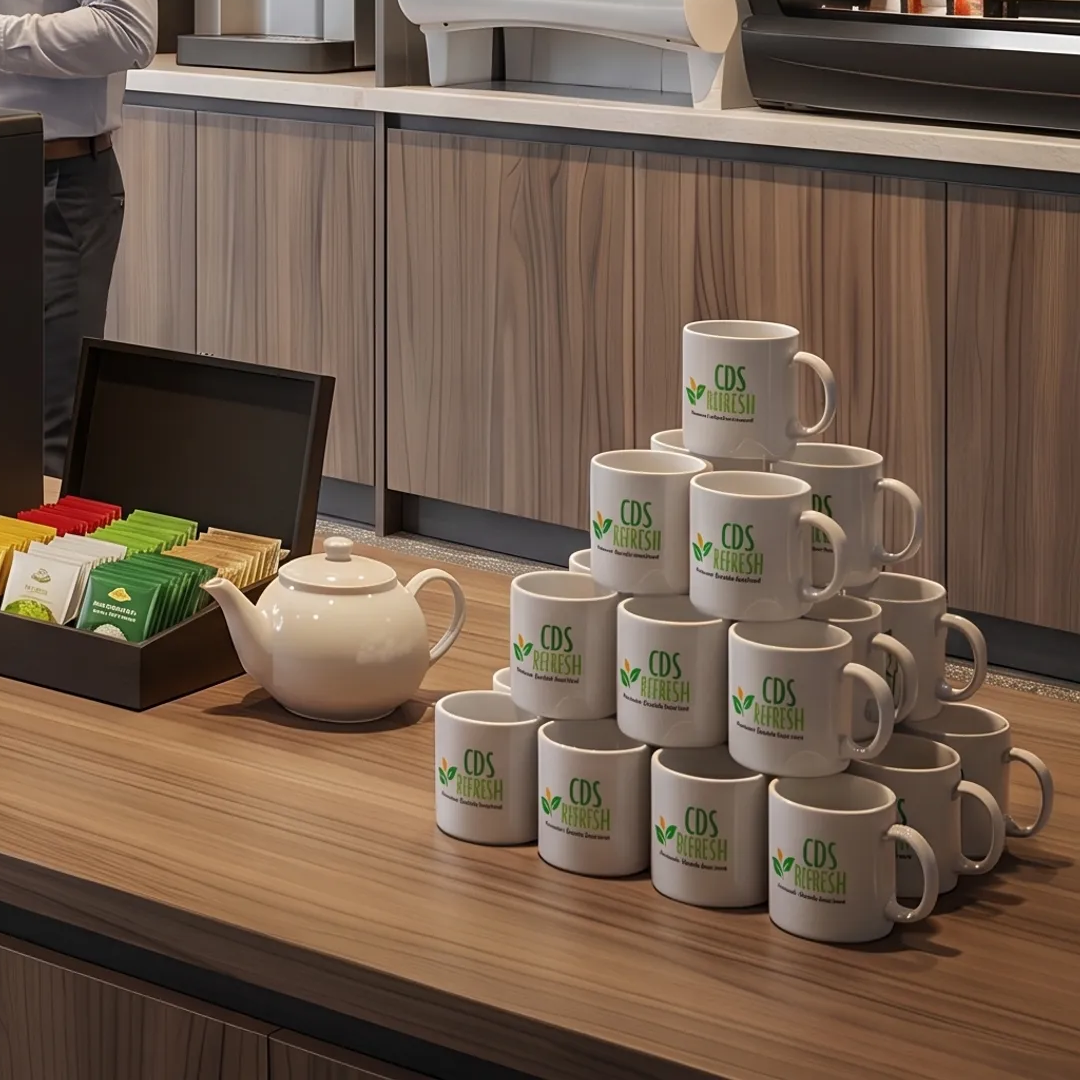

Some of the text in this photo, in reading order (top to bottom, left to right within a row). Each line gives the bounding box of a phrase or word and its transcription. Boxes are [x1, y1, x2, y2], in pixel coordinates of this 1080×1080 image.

[714, 364, 746, 392] CDS
[620, 499, 652, 528] CDS
[721, 522, 755, 552] CDS
[541, 624, 573, 652] CDS
[649, 650, 681, 679] CDS
[763, 676, 796, 707] CDS
[464, 748, 495, 778] CDS
[569, 777, 602, 808] CDS
[685, 806, 719, 837] CDS
[803, 838, 838, 870] CDS
